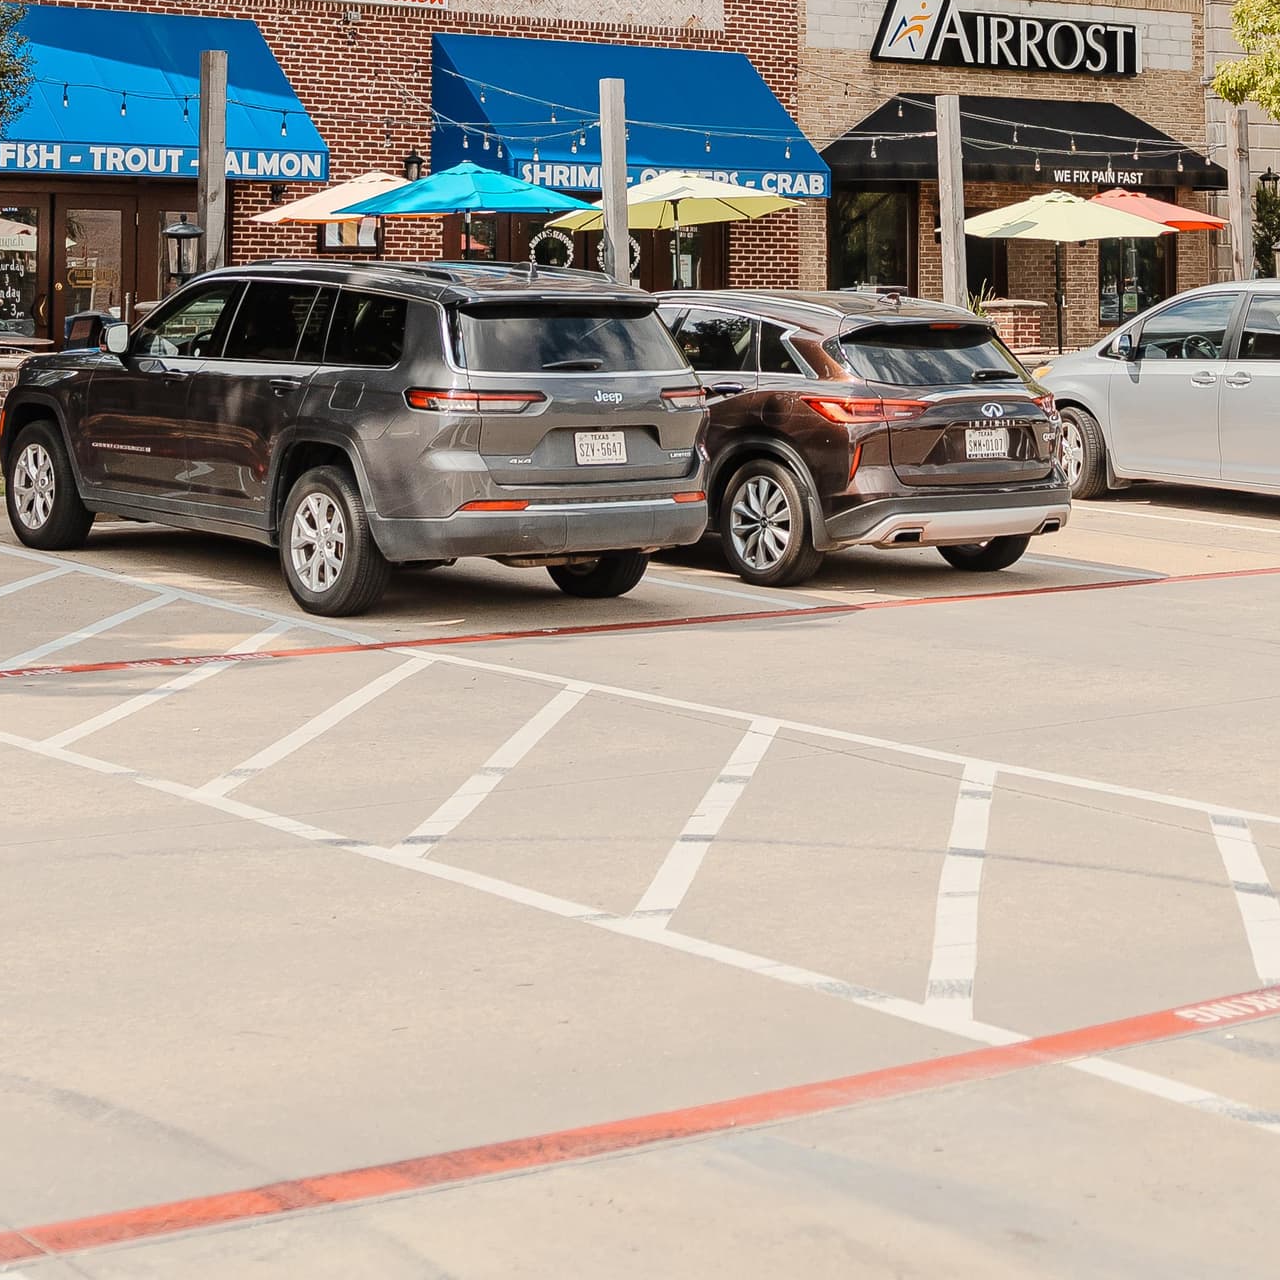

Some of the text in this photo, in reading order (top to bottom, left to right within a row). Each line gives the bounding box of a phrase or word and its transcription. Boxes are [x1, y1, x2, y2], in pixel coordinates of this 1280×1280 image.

[89, 146, 184, 174] TROUT
[224, 150, 321, 177] ALMON
[761, 172, 825, 196] CRAB
[1054, 170, 1144, 185] WE FIX PAIN FAST
[594, 389, 624, 405] Jeep
[590, 433, 609, 441] TEXAS
